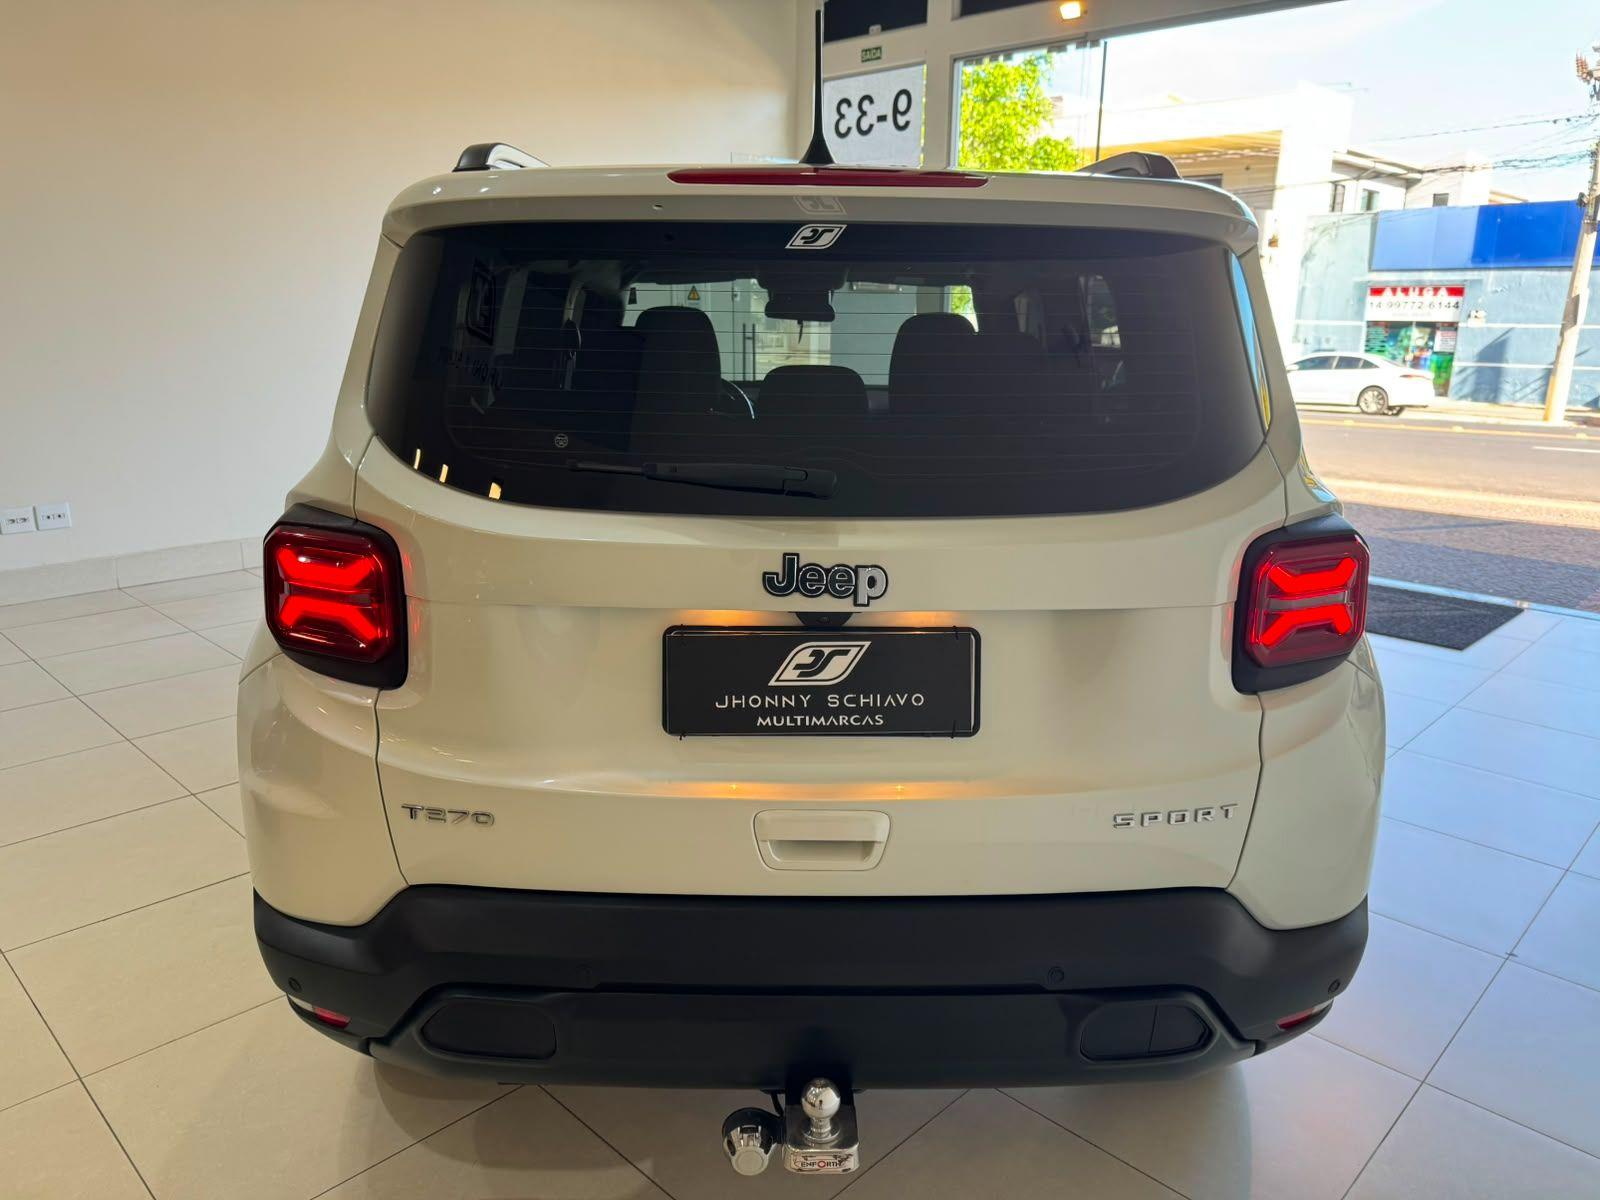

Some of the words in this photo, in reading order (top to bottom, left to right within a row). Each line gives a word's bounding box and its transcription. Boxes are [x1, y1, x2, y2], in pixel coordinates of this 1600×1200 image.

[1381, 287, 1448, 297] ALUGA
[762, 552, 889, 607] Jeep
[715, 694, 811, 708] JHONNY
[827, 693, 924, 707] SCHIAVO
[756, 714, 884, 726] MULTIMARCAS
[401, 803, 495, 827] T270
[1113, 803, 1238, 828] SPORT
